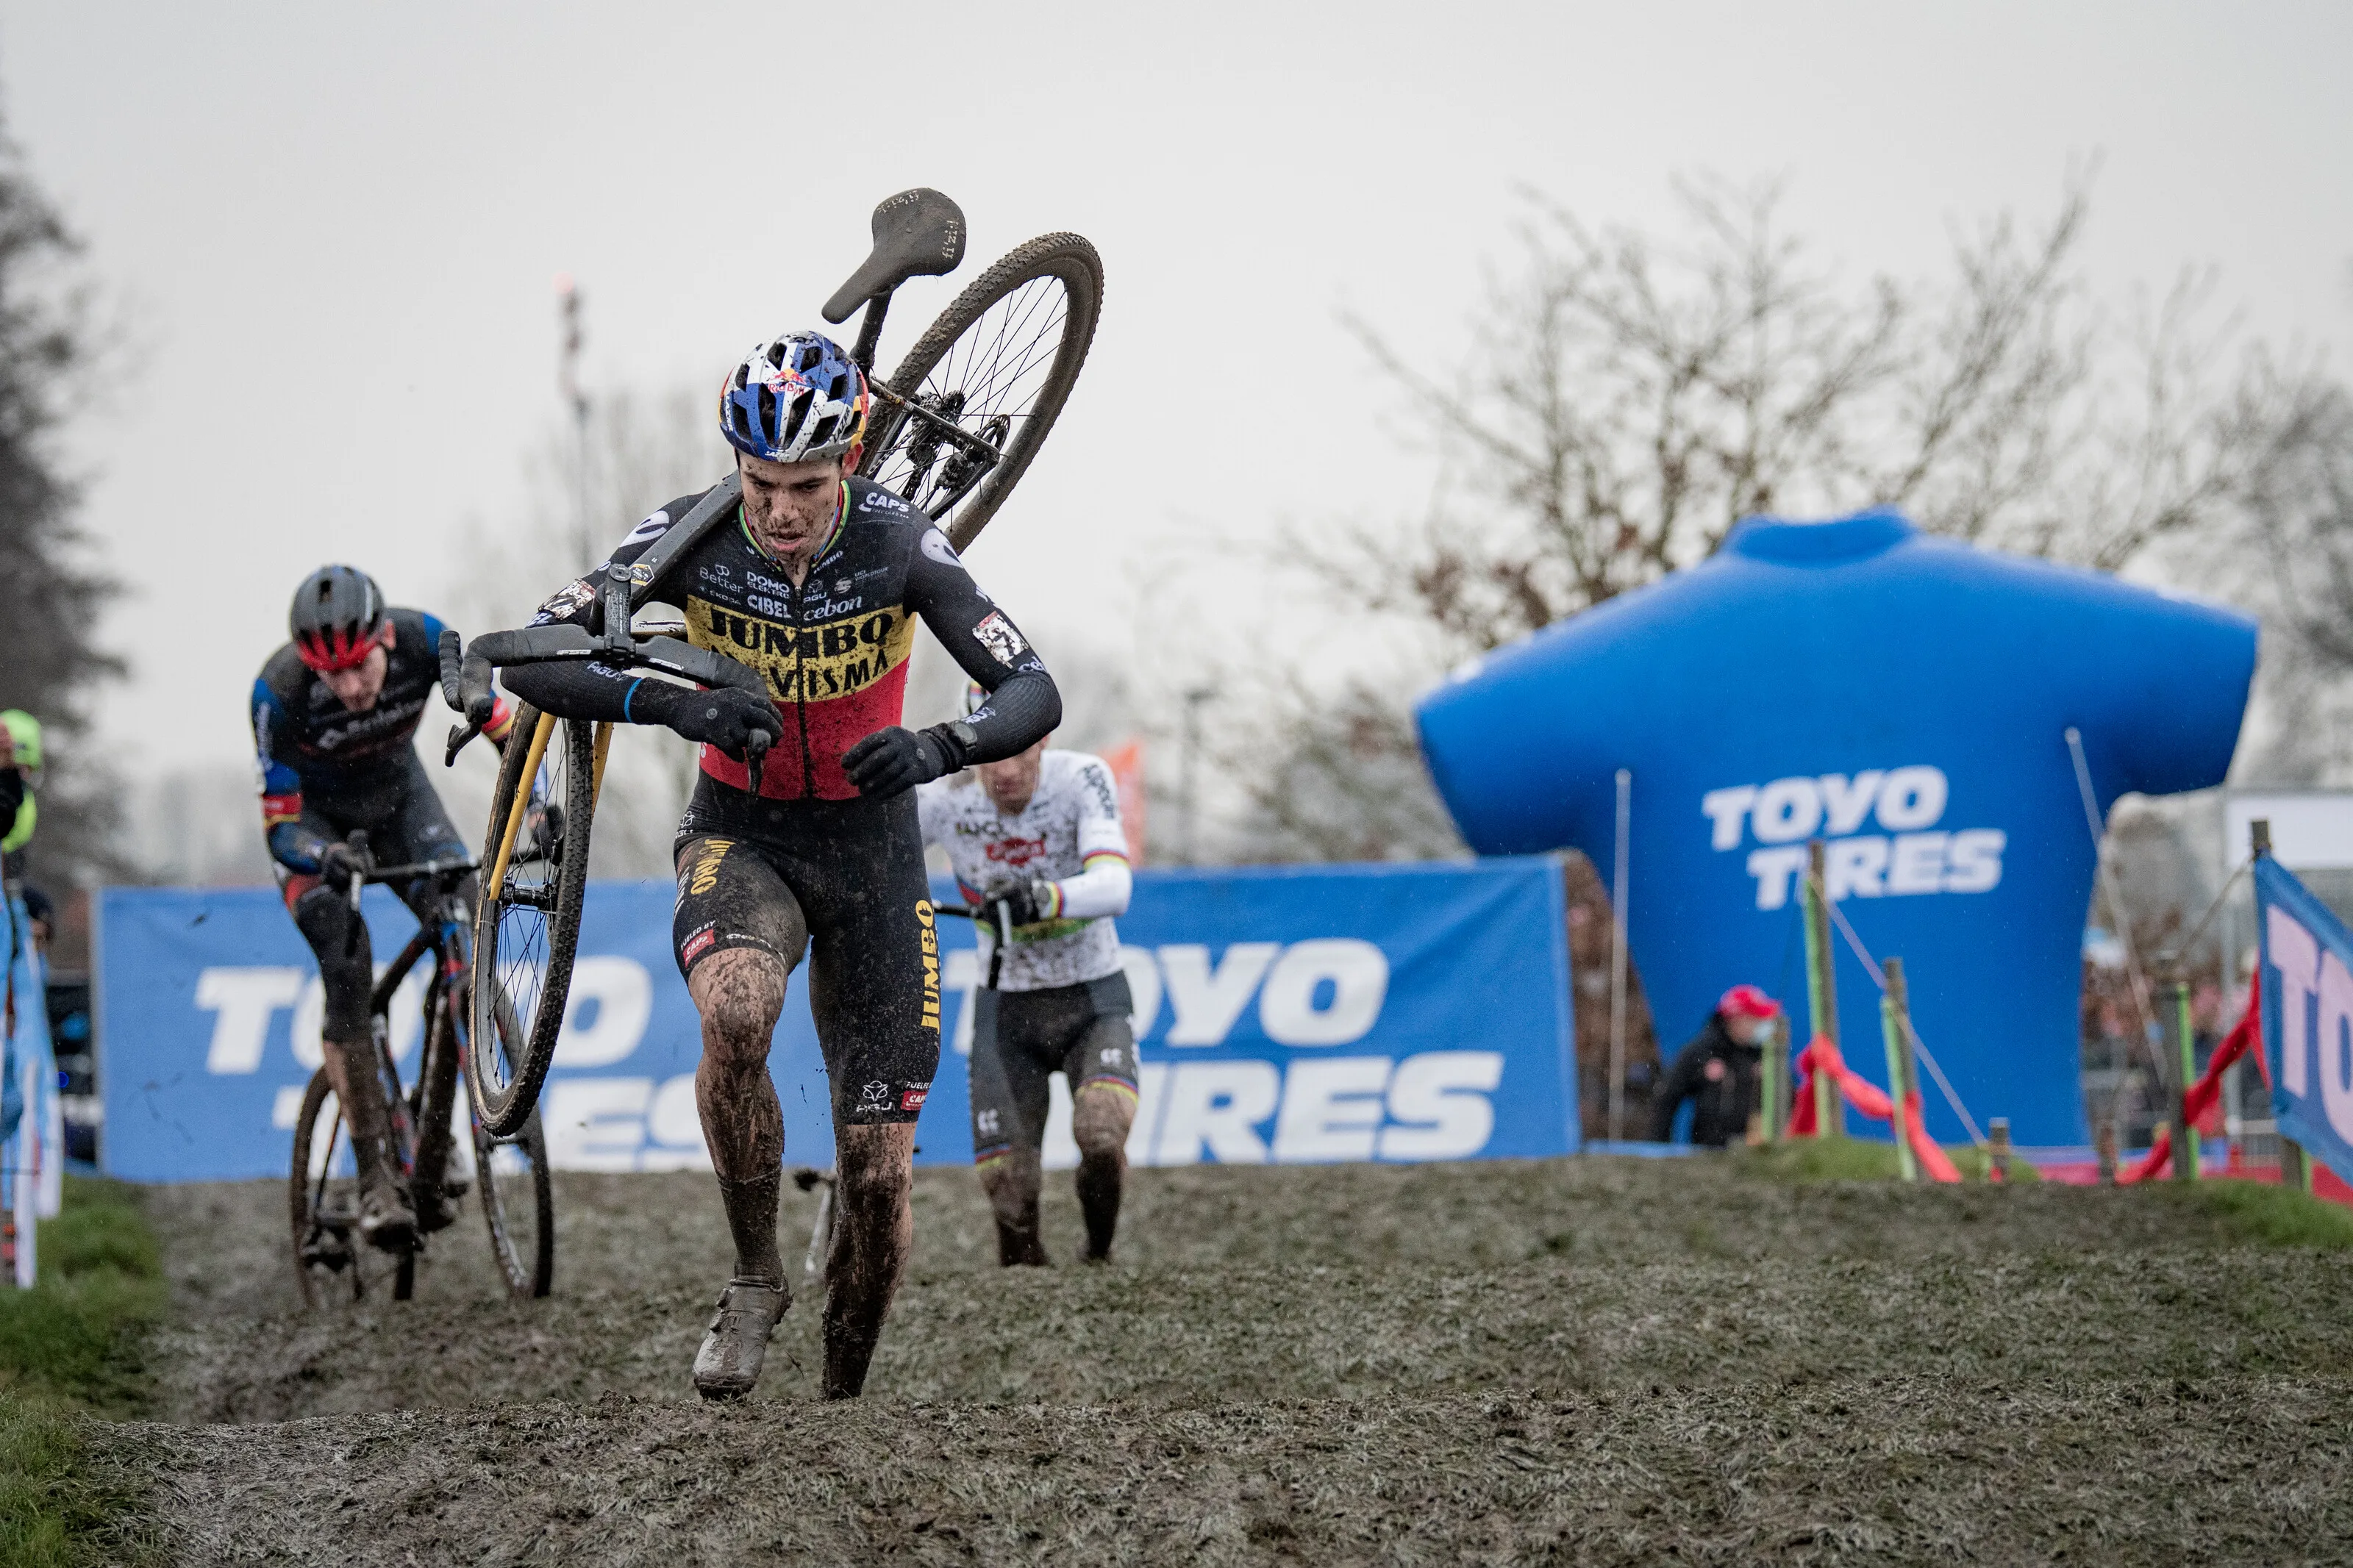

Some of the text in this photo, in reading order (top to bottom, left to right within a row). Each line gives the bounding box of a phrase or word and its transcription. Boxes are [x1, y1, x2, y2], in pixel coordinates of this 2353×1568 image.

[865, 492, 910, 512] CAPS
[699, 567, 743, 593] Better
[746, 571, 790, 593] DOMO
[803, 591, 827, 604] AGU
[854, 570, 866, 578] UCI
[747, 594, 792, 618] CIBEL
[708, 609, 893, 658] JUMBO
[768, 648, 889, 698] VISMA
[1702, 764, 1950, 853] TOYO
[915, 899, 941, 1035] JUMBO
[195, 956, 653, 1075] TOO
[944, 937, 1389, 1055] YO
[1039, 1050, 1504, 1167] RES
